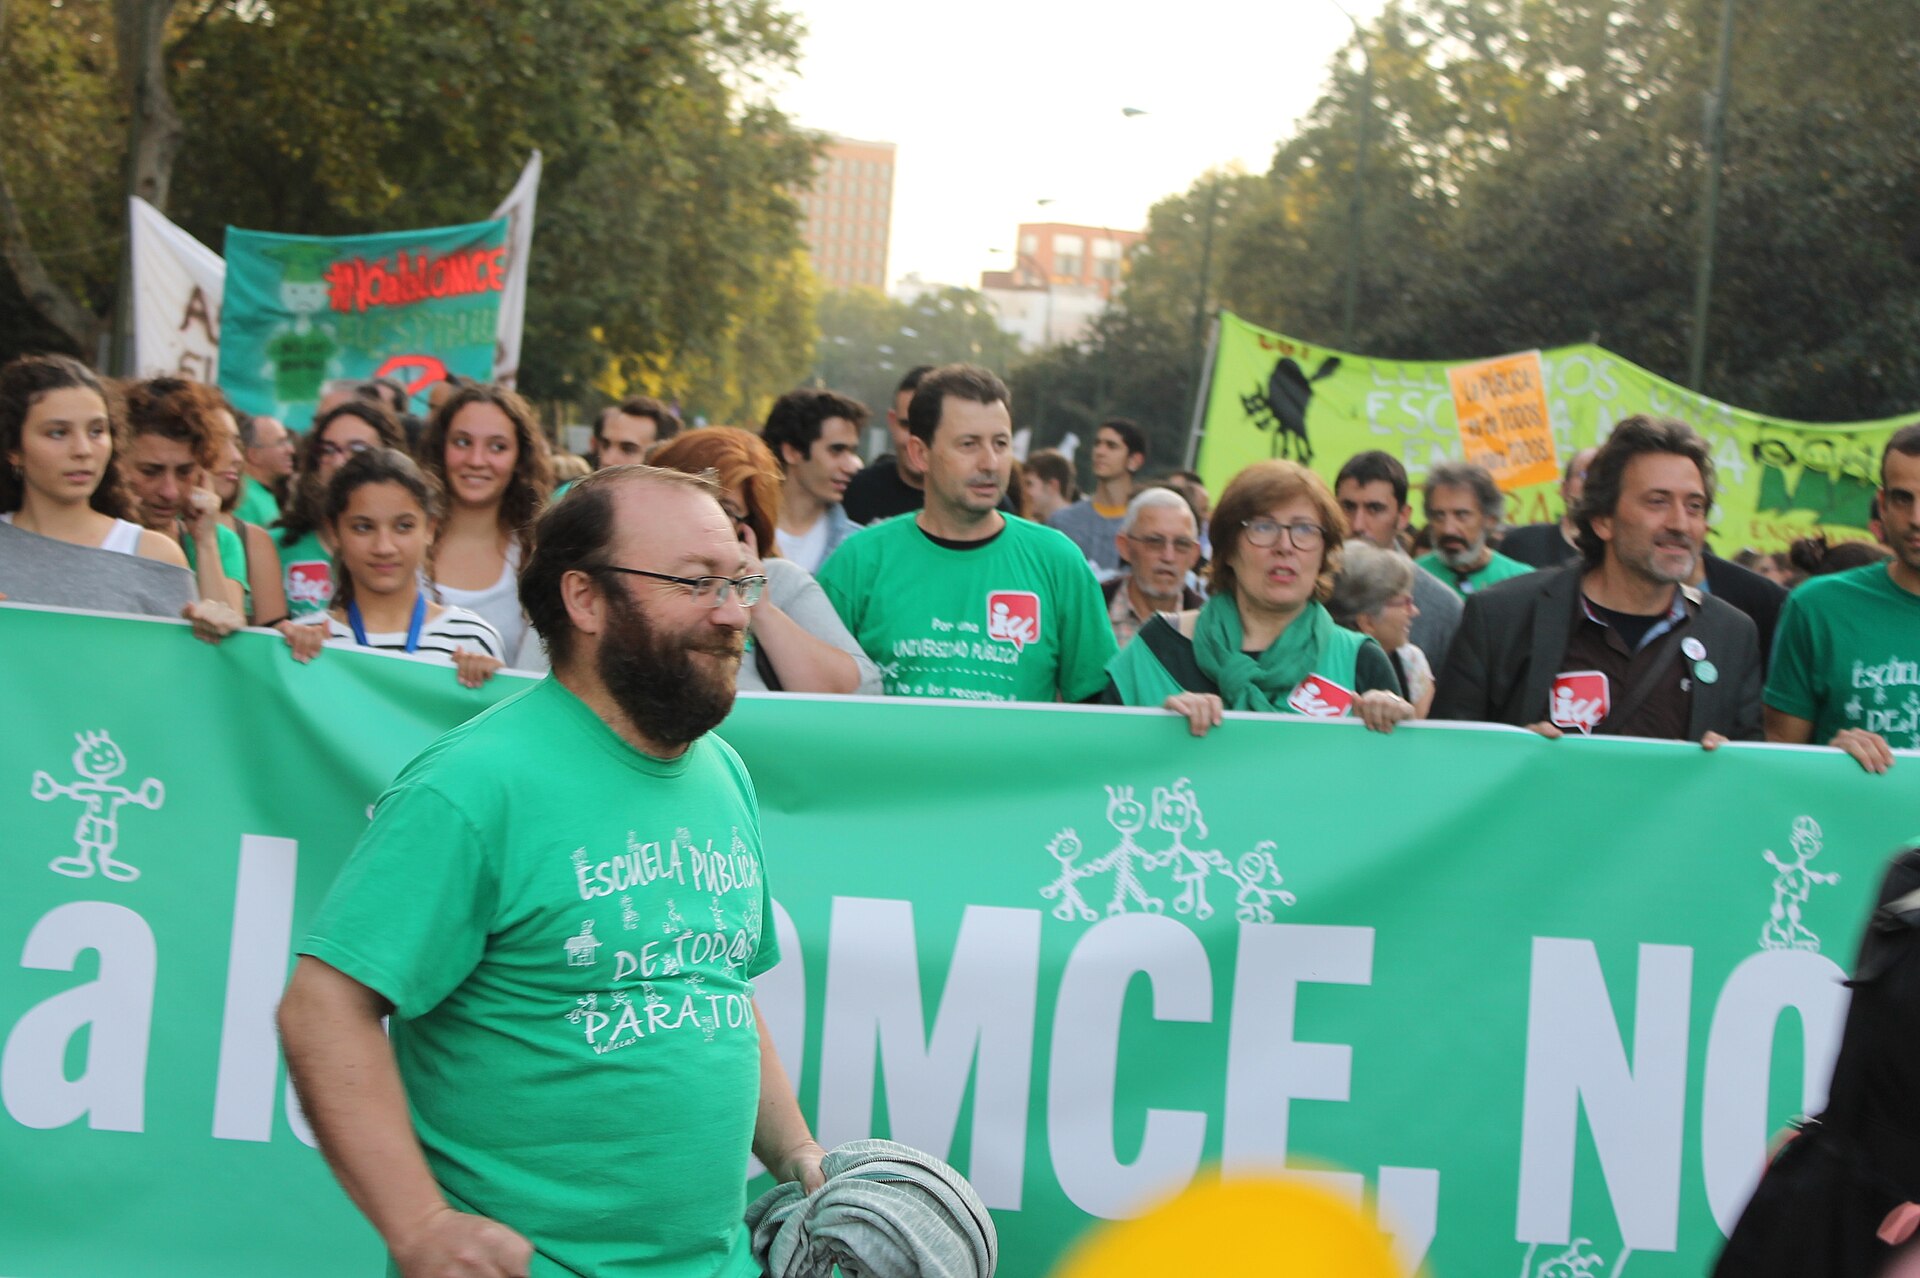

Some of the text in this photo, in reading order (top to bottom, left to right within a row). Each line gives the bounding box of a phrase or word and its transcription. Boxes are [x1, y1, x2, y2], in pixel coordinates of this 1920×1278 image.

[893, 638, 969, 658] UNIVERSIDAD
[931, 617, 980, 634] Por una
[576, 839, 686, 900] ESCUELA
[612, 941, 660, 982] DE
[2, 901, 157, 1134] a
[212, 833, 322, 1150] l
[582, 993, 755, 1044] PARA TOD
